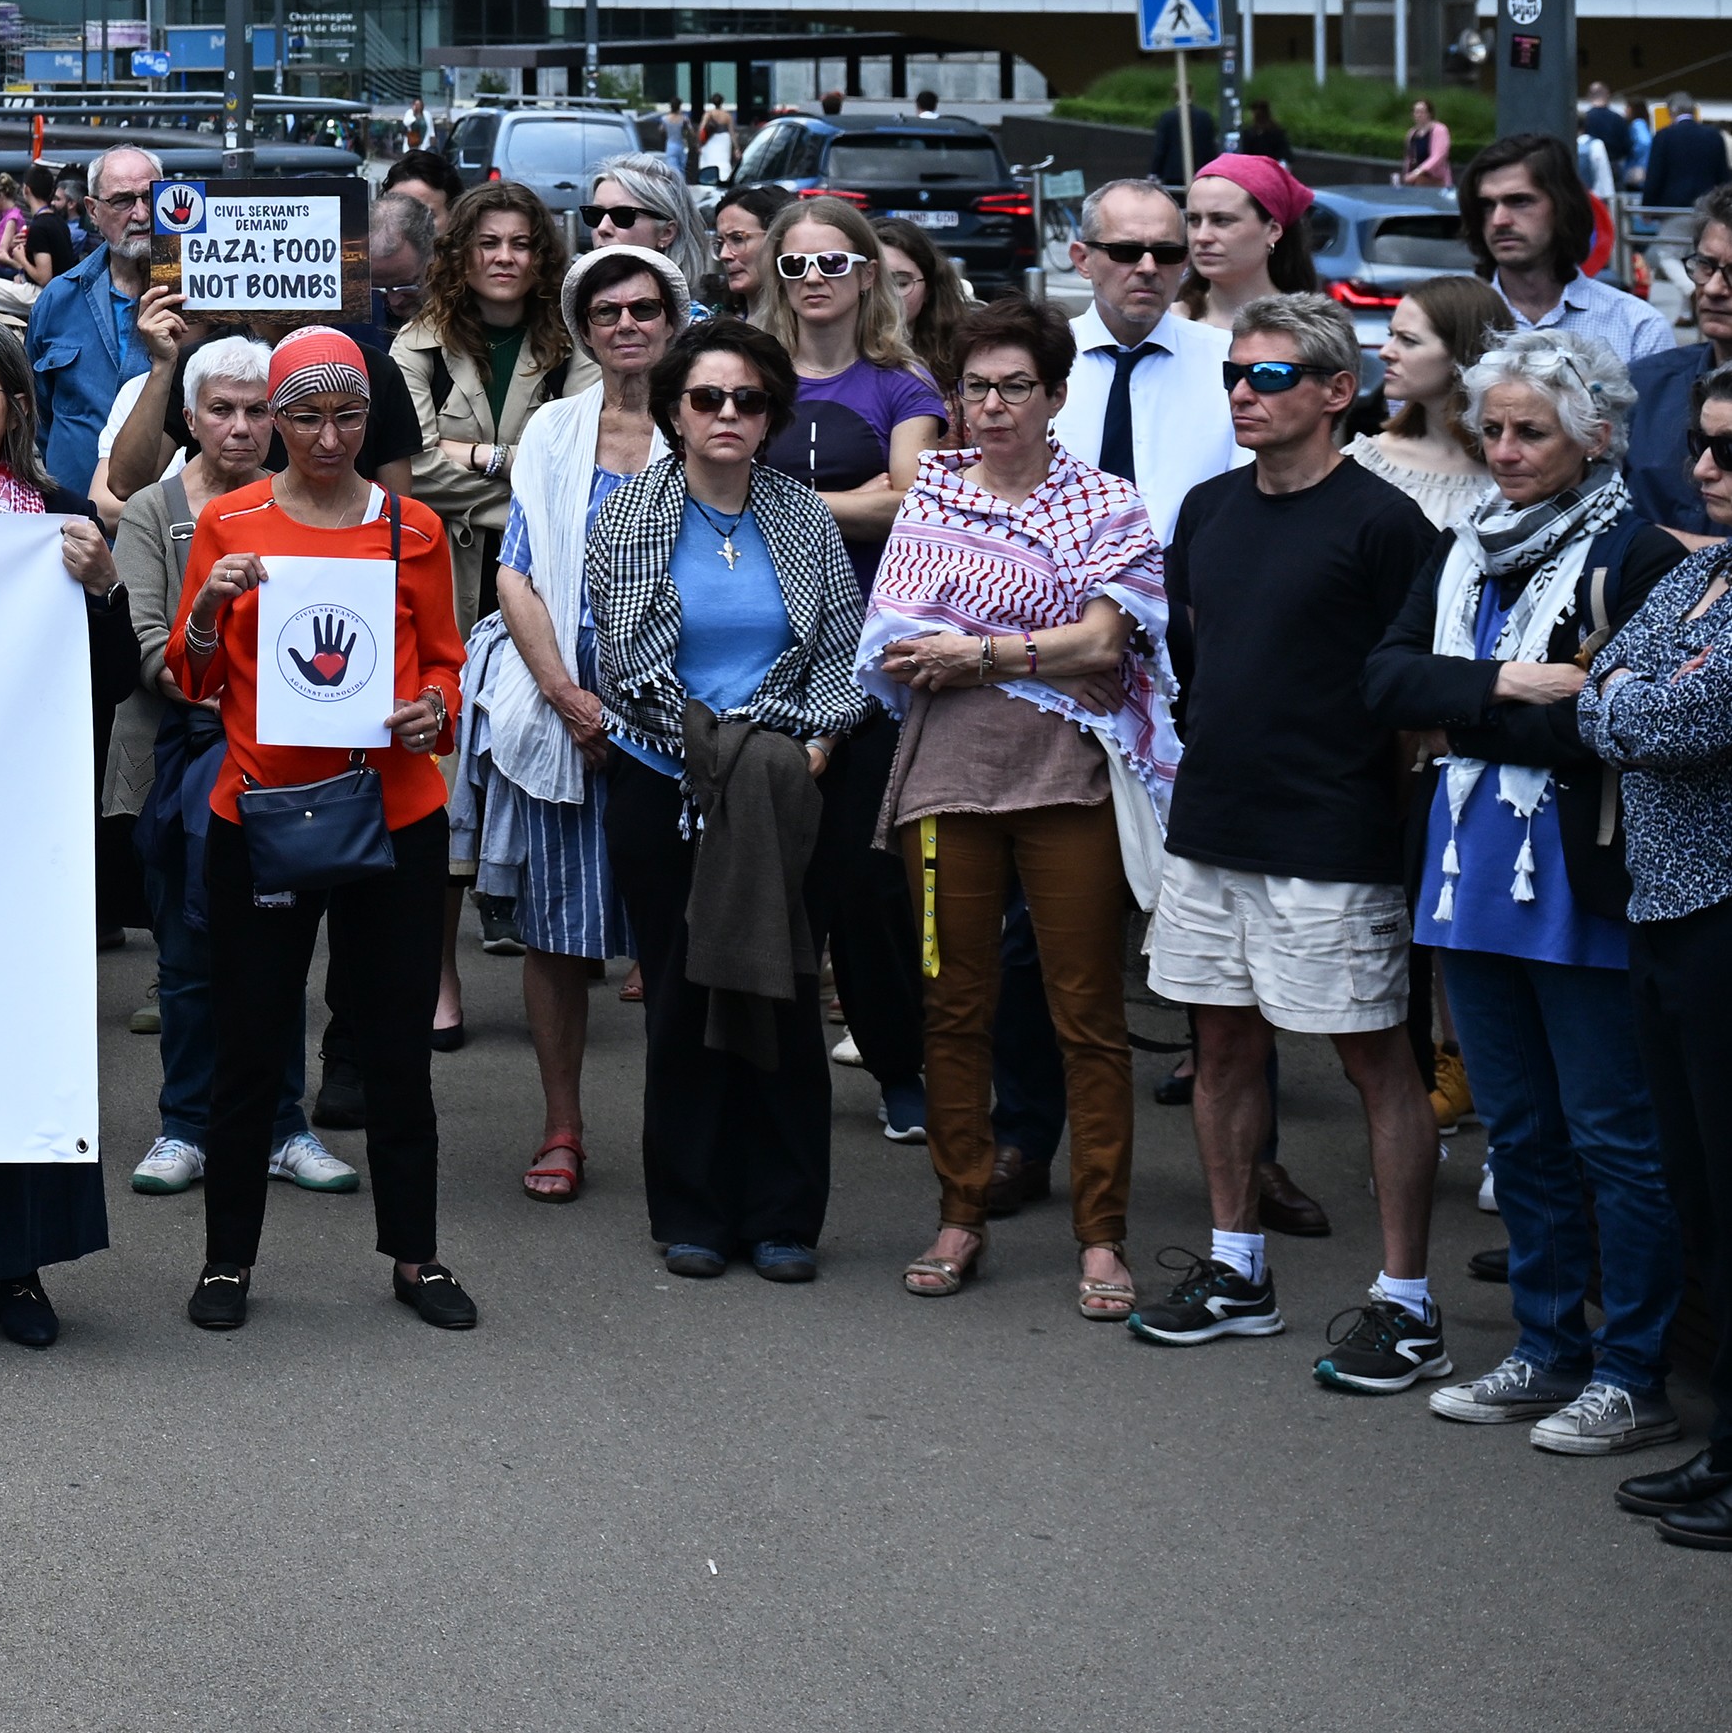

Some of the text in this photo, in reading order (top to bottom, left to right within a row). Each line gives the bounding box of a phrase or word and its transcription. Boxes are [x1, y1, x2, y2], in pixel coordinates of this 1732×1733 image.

[289, 12, 353, 23] Charlemagne
[288, 24, 312, 33] arel
[315, 25, 327, 33] de
[214, 205, 310, 218] CIVIL SERVANTS
[235, 219, 288, 231] DEMAND
[188, 238, 336, 264] GAZA: FOOD
[189, 274, 337, 299] NOT BOMBS
[295, 608, 360, 623] CIVIL SERVANTS
[289, 677, 365, 698] AGAINST GENOCIDE
